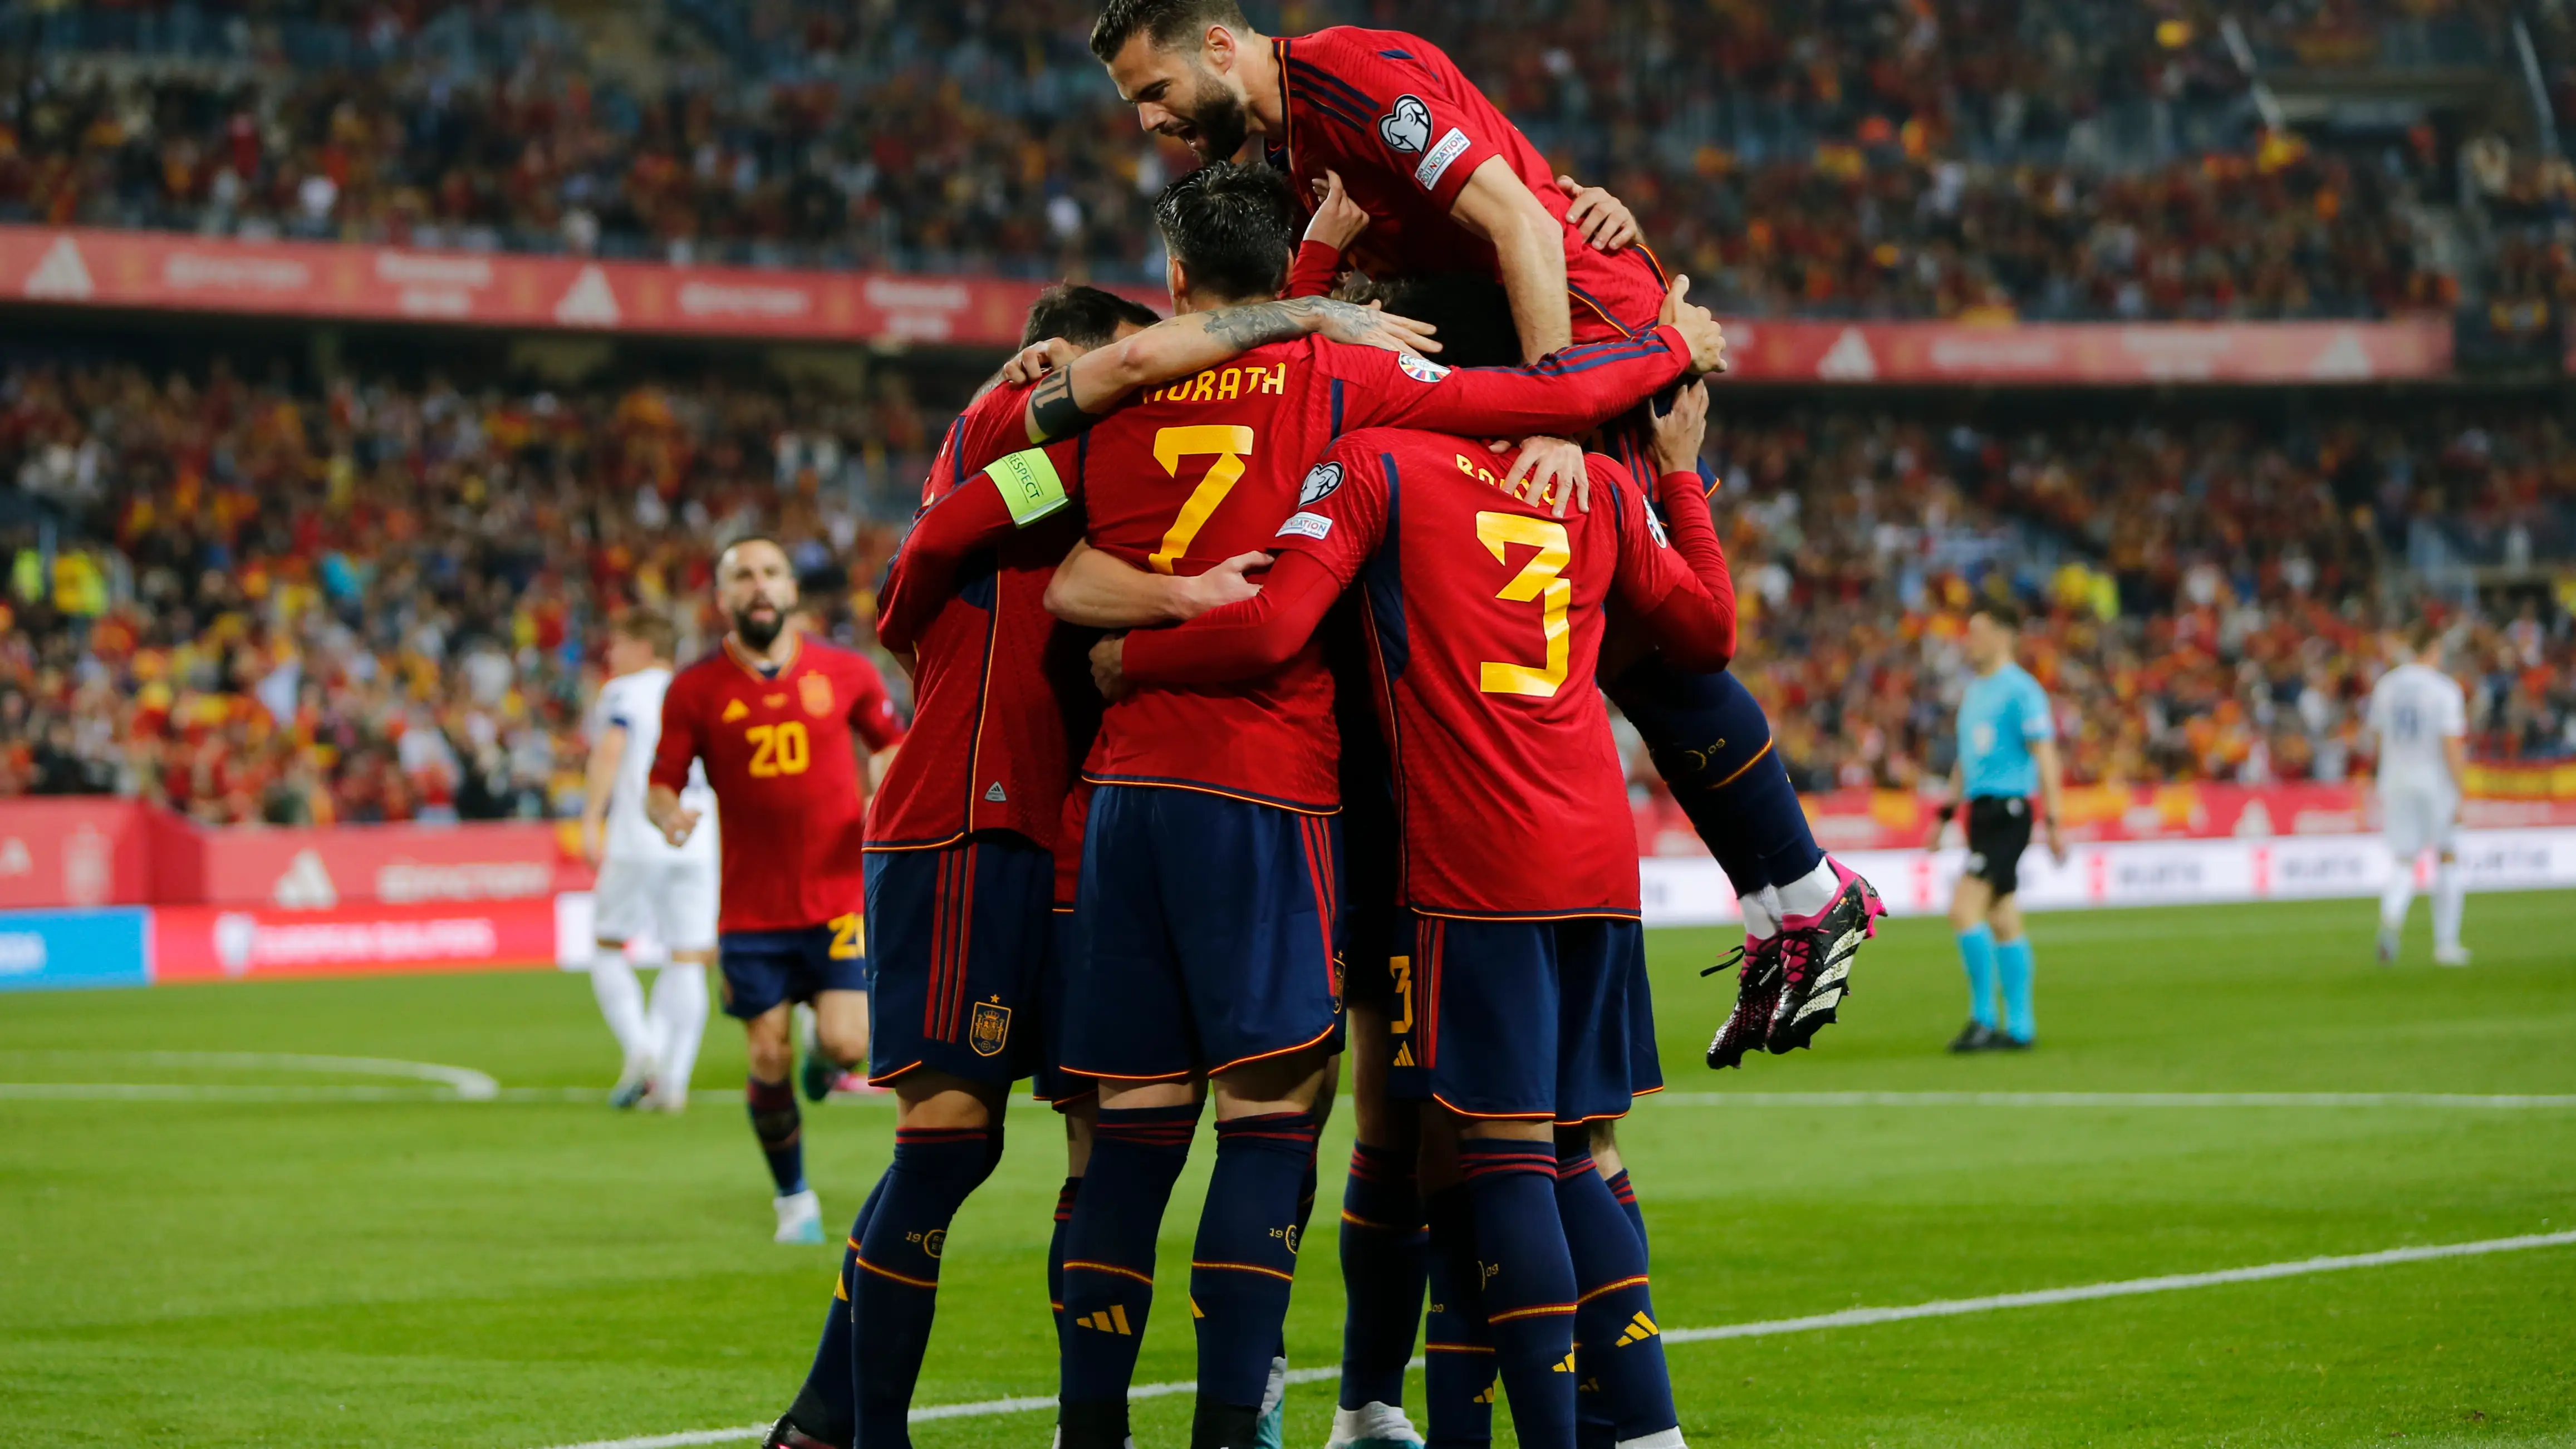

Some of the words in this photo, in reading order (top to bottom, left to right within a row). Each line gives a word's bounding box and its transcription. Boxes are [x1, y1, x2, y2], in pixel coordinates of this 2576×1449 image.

[1421, 134, 1464, 185] FOUNDATION
[1007, 454, 1040, 498] RESPECT
[1149, 424, 1254, 576] 7
[1475, 510, 1571, 698] 3
[745, 720, 809, 778] 20
[1389, 955, 1413, 1034] 3
[905, 1231, 922, 1243] 19
[1269, 1227, 1283, 1238] 19
